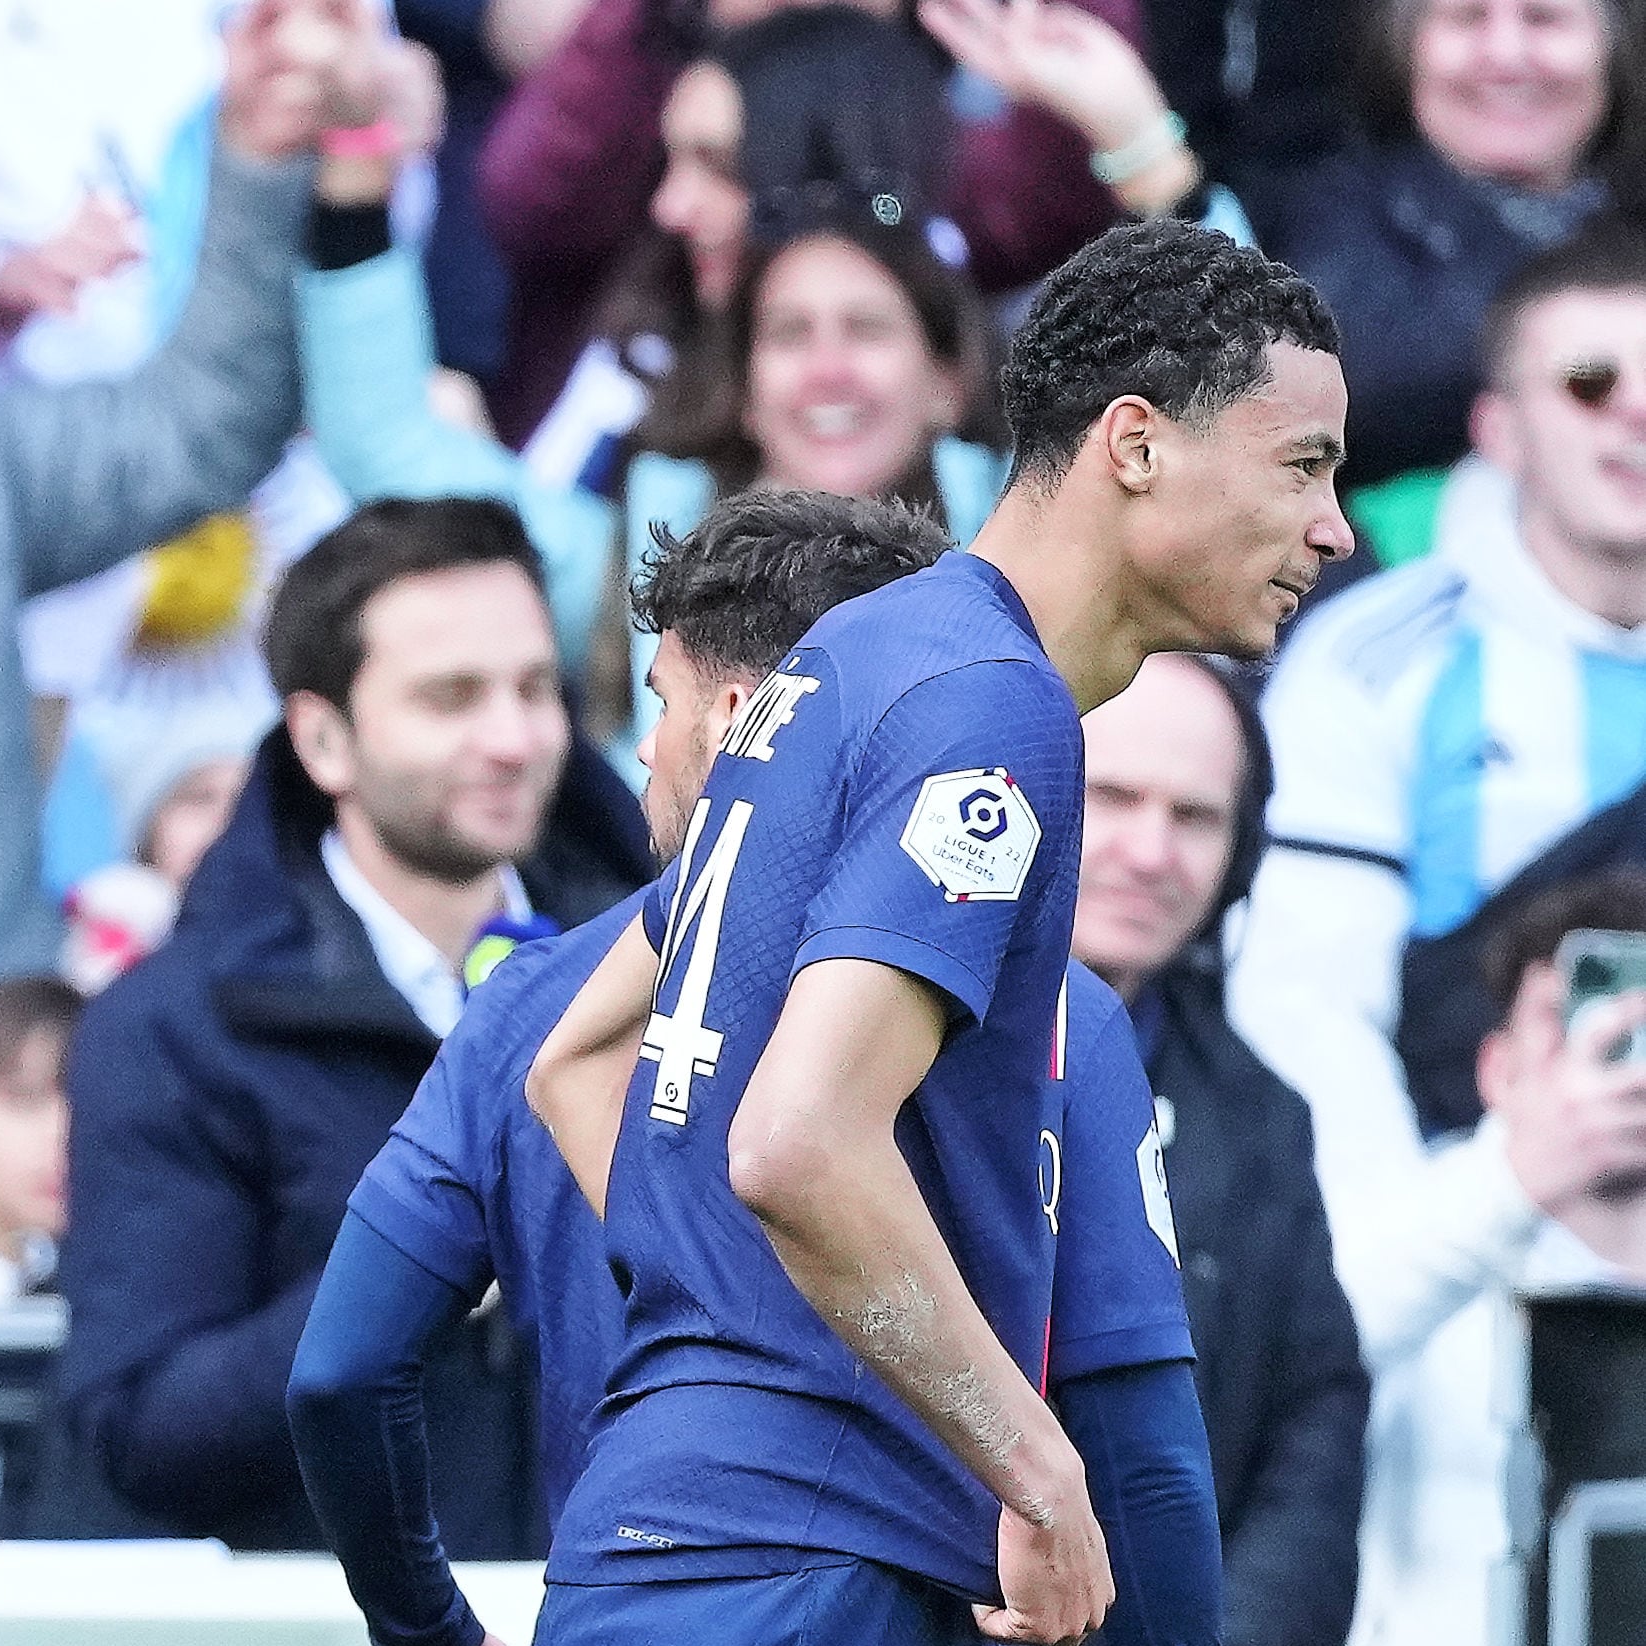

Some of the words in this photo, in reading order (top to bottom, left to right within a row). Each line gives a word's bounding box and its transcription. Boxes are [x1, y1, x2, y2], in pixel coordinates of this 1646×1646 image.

[932, 845, 963, 865] Uber
[965, 858, 995, 882] Eats
[944, 834, 987, 861] LIGUE
